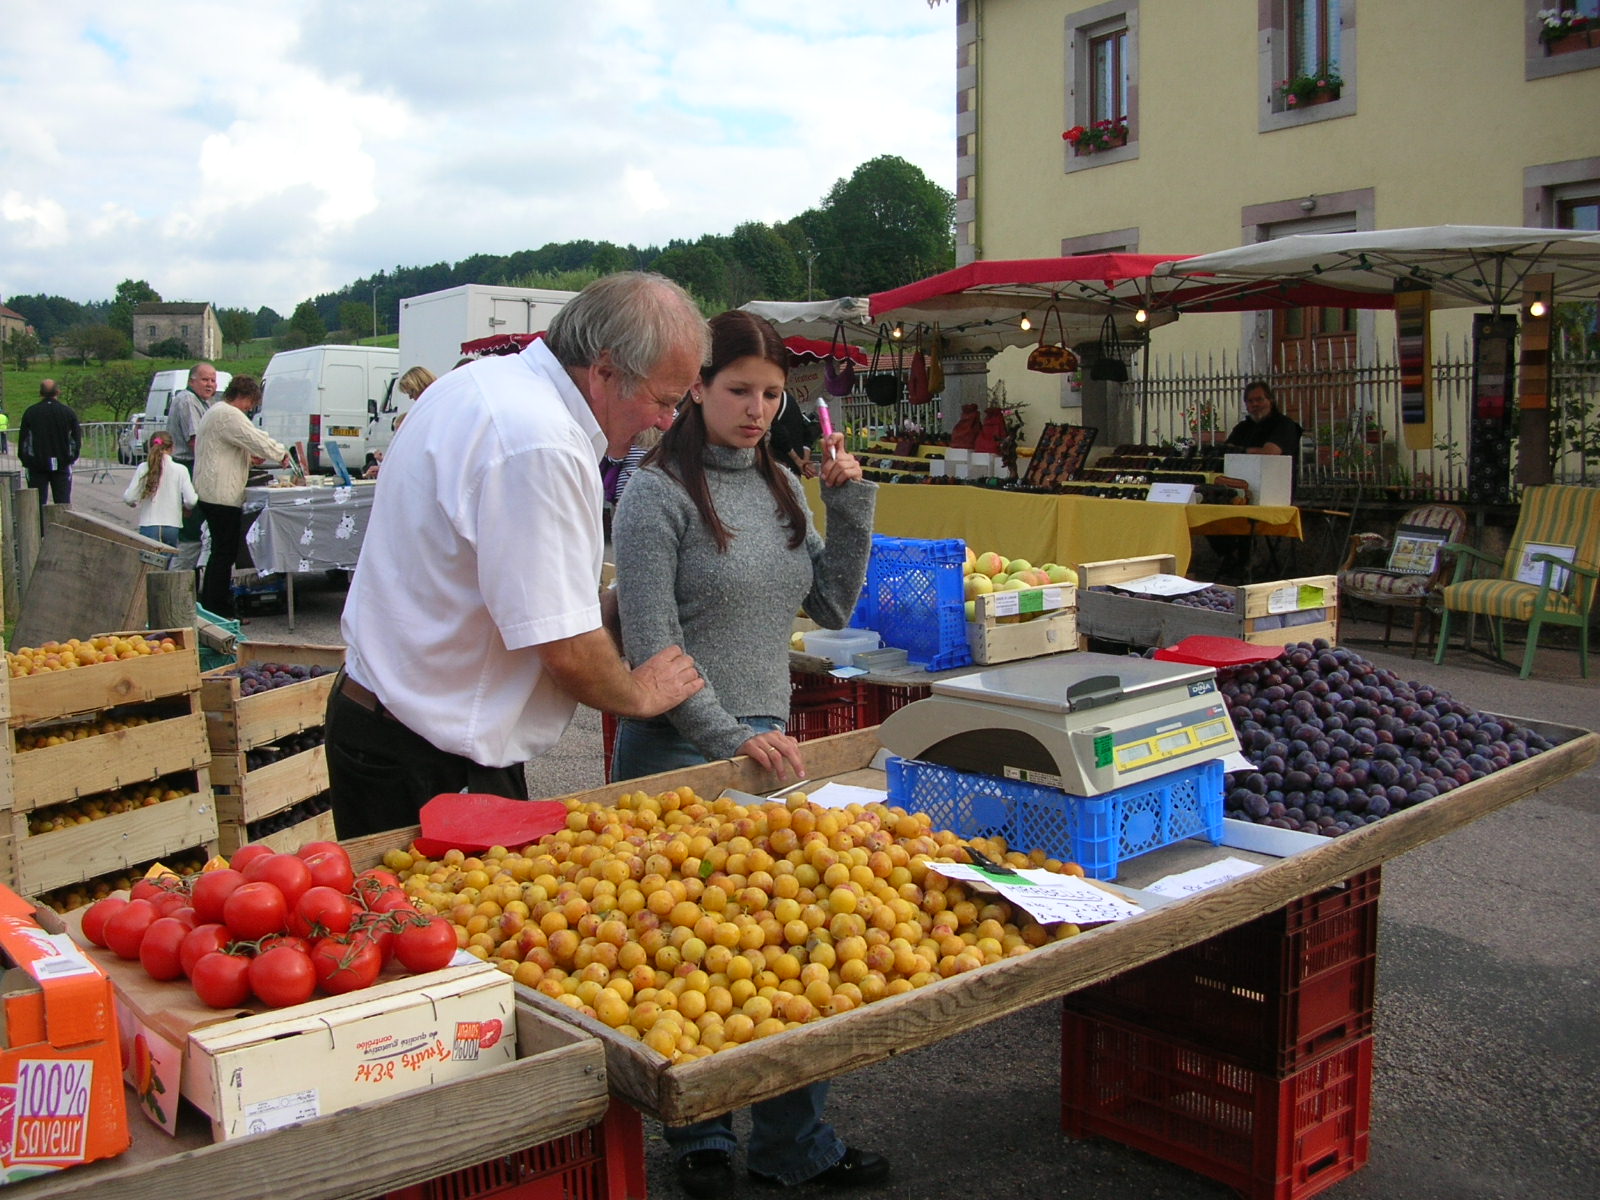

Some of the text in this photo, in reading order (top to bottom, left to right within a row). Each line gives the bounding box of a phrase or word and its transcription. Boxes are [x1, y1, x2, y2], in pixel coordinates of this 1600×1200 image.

[401, 1032, 427, 1047] qualité
[457, 1023, 480, 1039] saveur
[364, 1039, 399, 1055] gustative
[401, 1039, 452, 1072] Fruits
[454, 1039, 480, 1060] 100%
[19, 1062, 88, 1119] 100%
[20, 1119, 81, 1154] saveur
